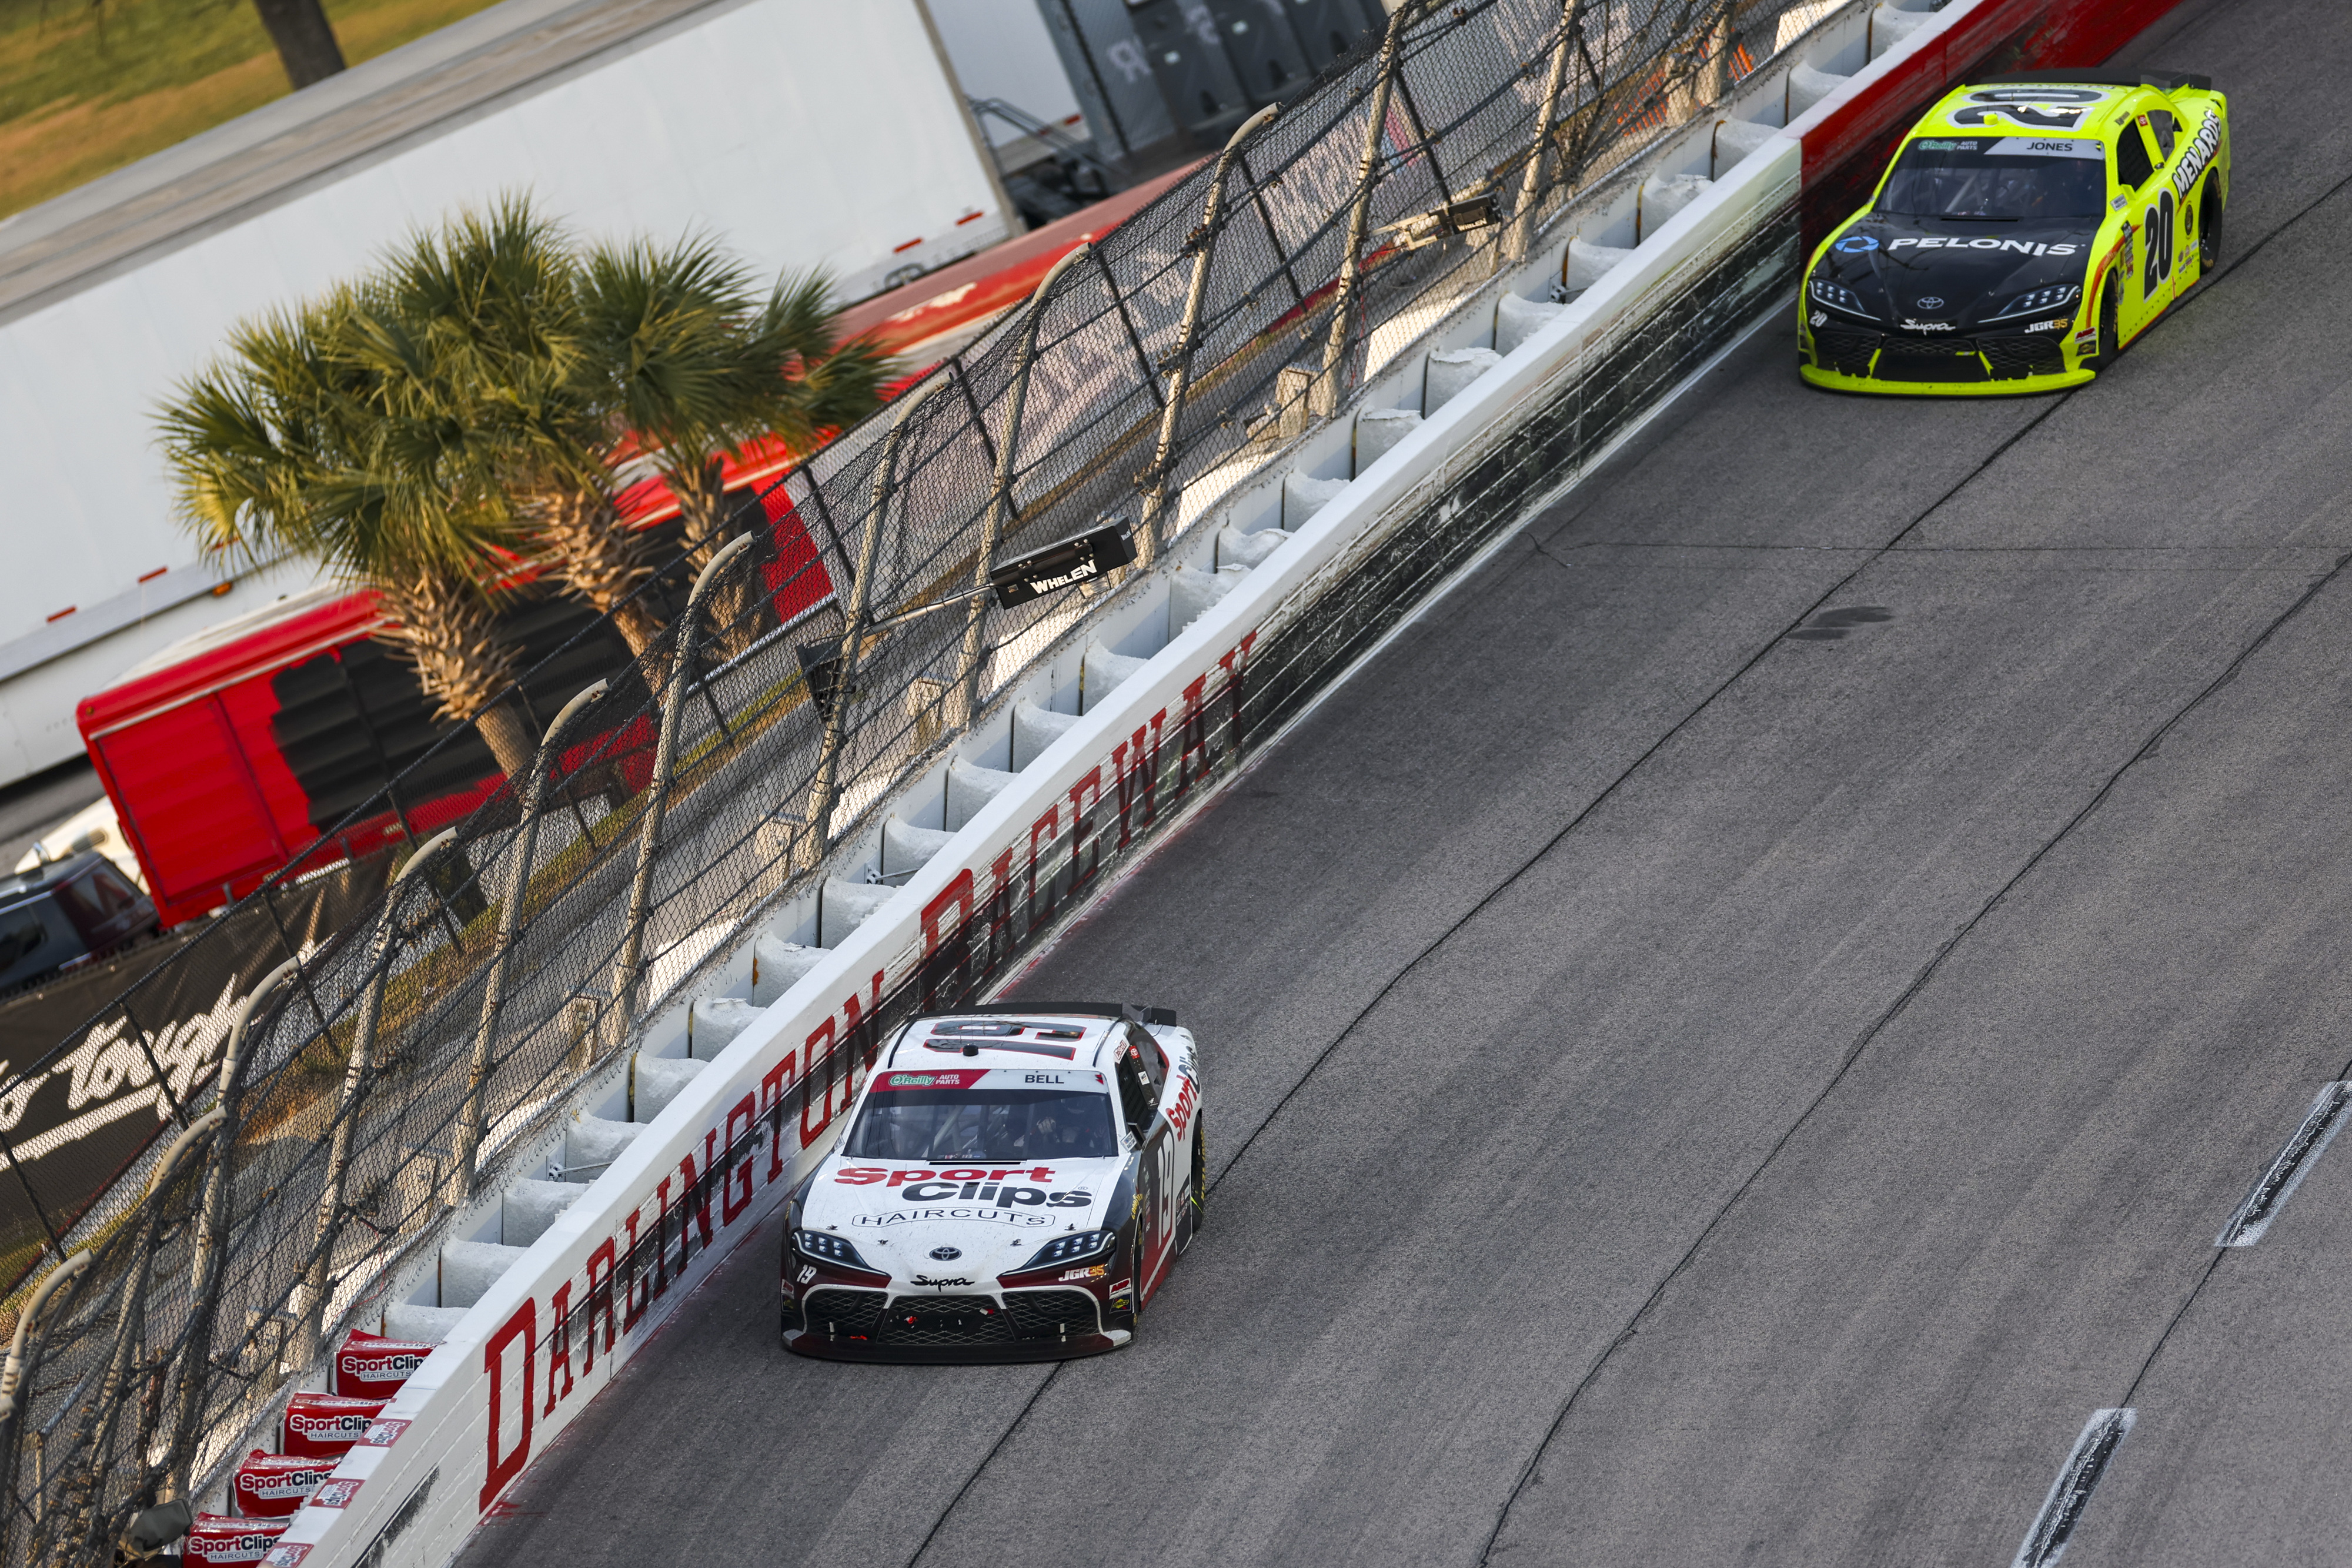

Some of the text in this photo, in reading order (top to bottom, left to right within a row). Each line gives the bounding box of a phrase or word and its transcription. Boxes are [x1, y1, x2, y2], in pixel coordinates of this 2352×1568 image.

[1946, 88, 2110, 131] 20
[2027, 142, 2073, 152] JONES
[2172, 110, 2221, 203] MENARDS
[1457, 218, 1488, 231] WHELEN
[1888, 238, 2079, 256] PELONIS
[2144, 188, 2174, 303] 20
[1809, 310, 1828, 327] 20
[1900, 319, 1956, 336] Supra
[1030, 559, 1097, 594] WHELEN
[479, 968, 884, 1516] DARLINGTON
[919, 630, 1257, 1009] RACEWAY
[889, 1074, 937, 1086] O'Reilly
[1025, 1075, 1064, 1084] BELL
[834, 1166, 1056, 1187] Sport
[902, 1182, 1093, 1208] Clips
[1157, 1131, 1174, 1249] 19
[861, 1209, 1046, 1226] HAIRCUTS
[796, 1264, 817, 1284] 19
[911, 1275, 975, 1292] Supra
[343, 1356, 427, 1373] SportClip
[292, 1416, 373, 1433] SportClip
[262, 1487, 311, 1496] HAIRCUTS
[211, 1551, 260, 1560] HAIRCUTS
